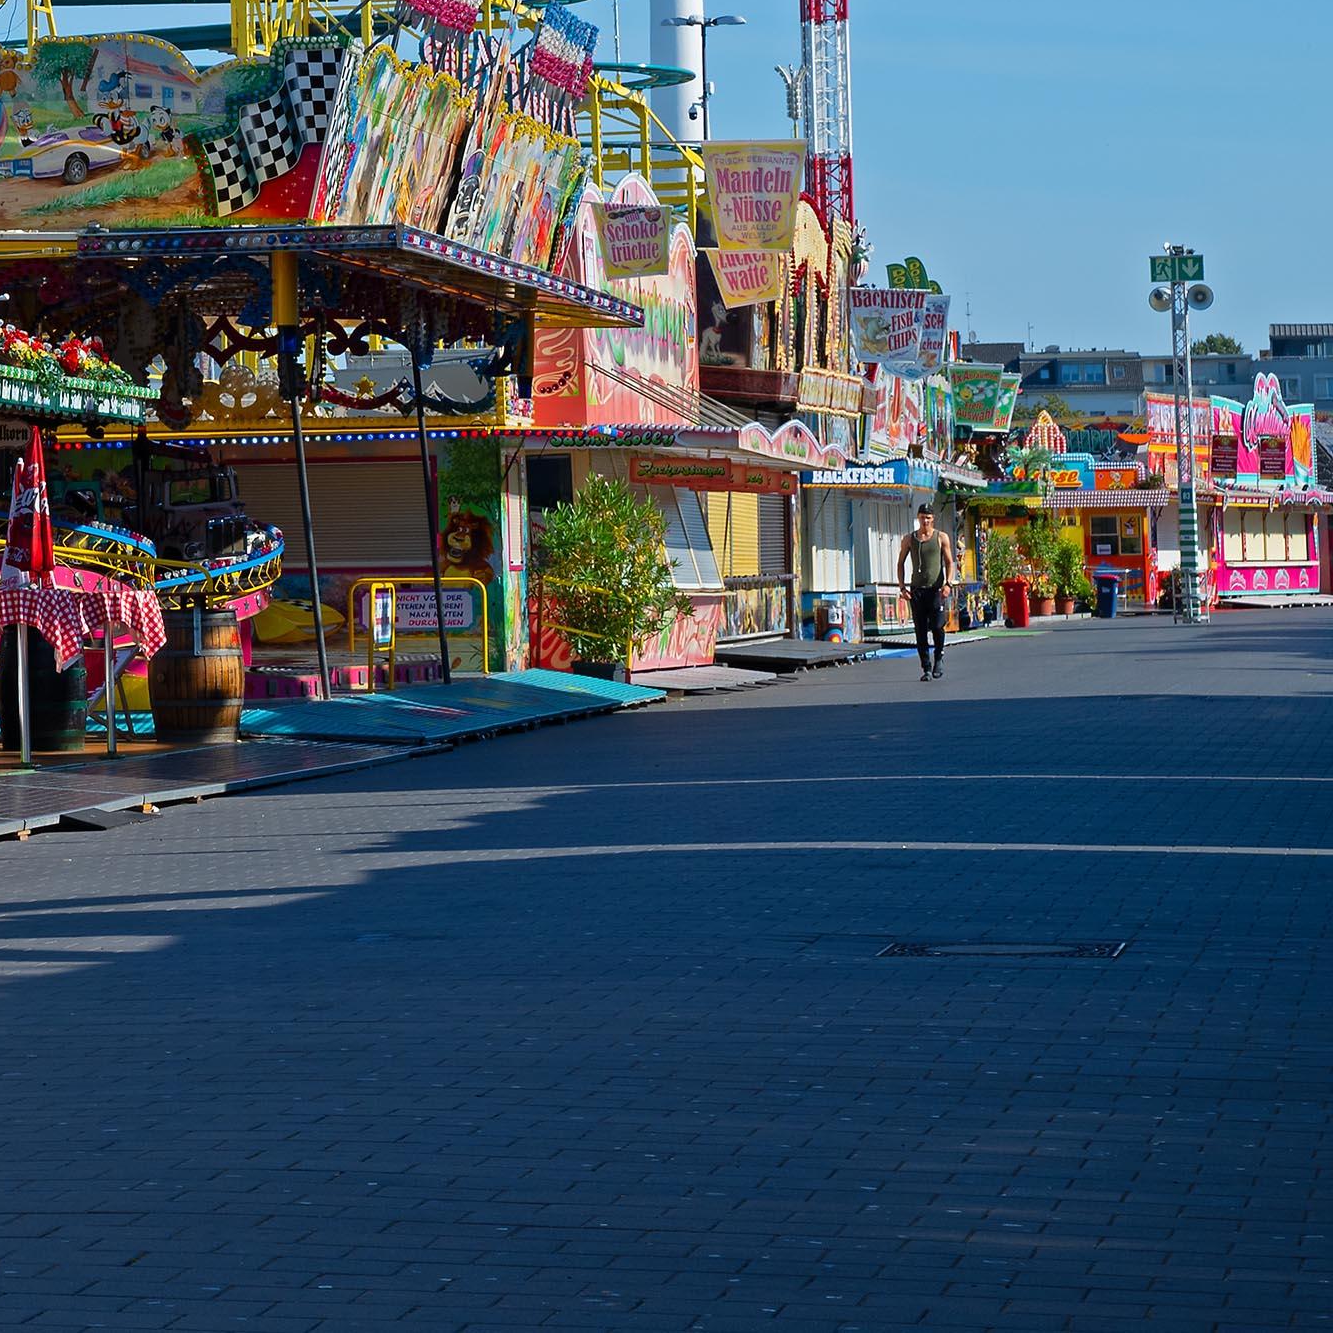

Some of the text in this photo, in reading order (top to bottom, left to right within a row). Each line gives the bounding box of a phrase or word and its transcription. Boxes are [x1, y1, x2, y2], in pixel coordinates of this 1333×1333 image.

[716, 167, 791, 194] Mandeln
[607, 221, 664, 243] Schoko-
[612, 242, 659, 263] früchte
[890, 311, 922, 333] FISH &
[887, 328, 919, 352] CHIPS
[812, 467, 895, 484] BACKFISCH
[423, 594, 438, 602] VO
[409, 611, 431, 619] NACH
